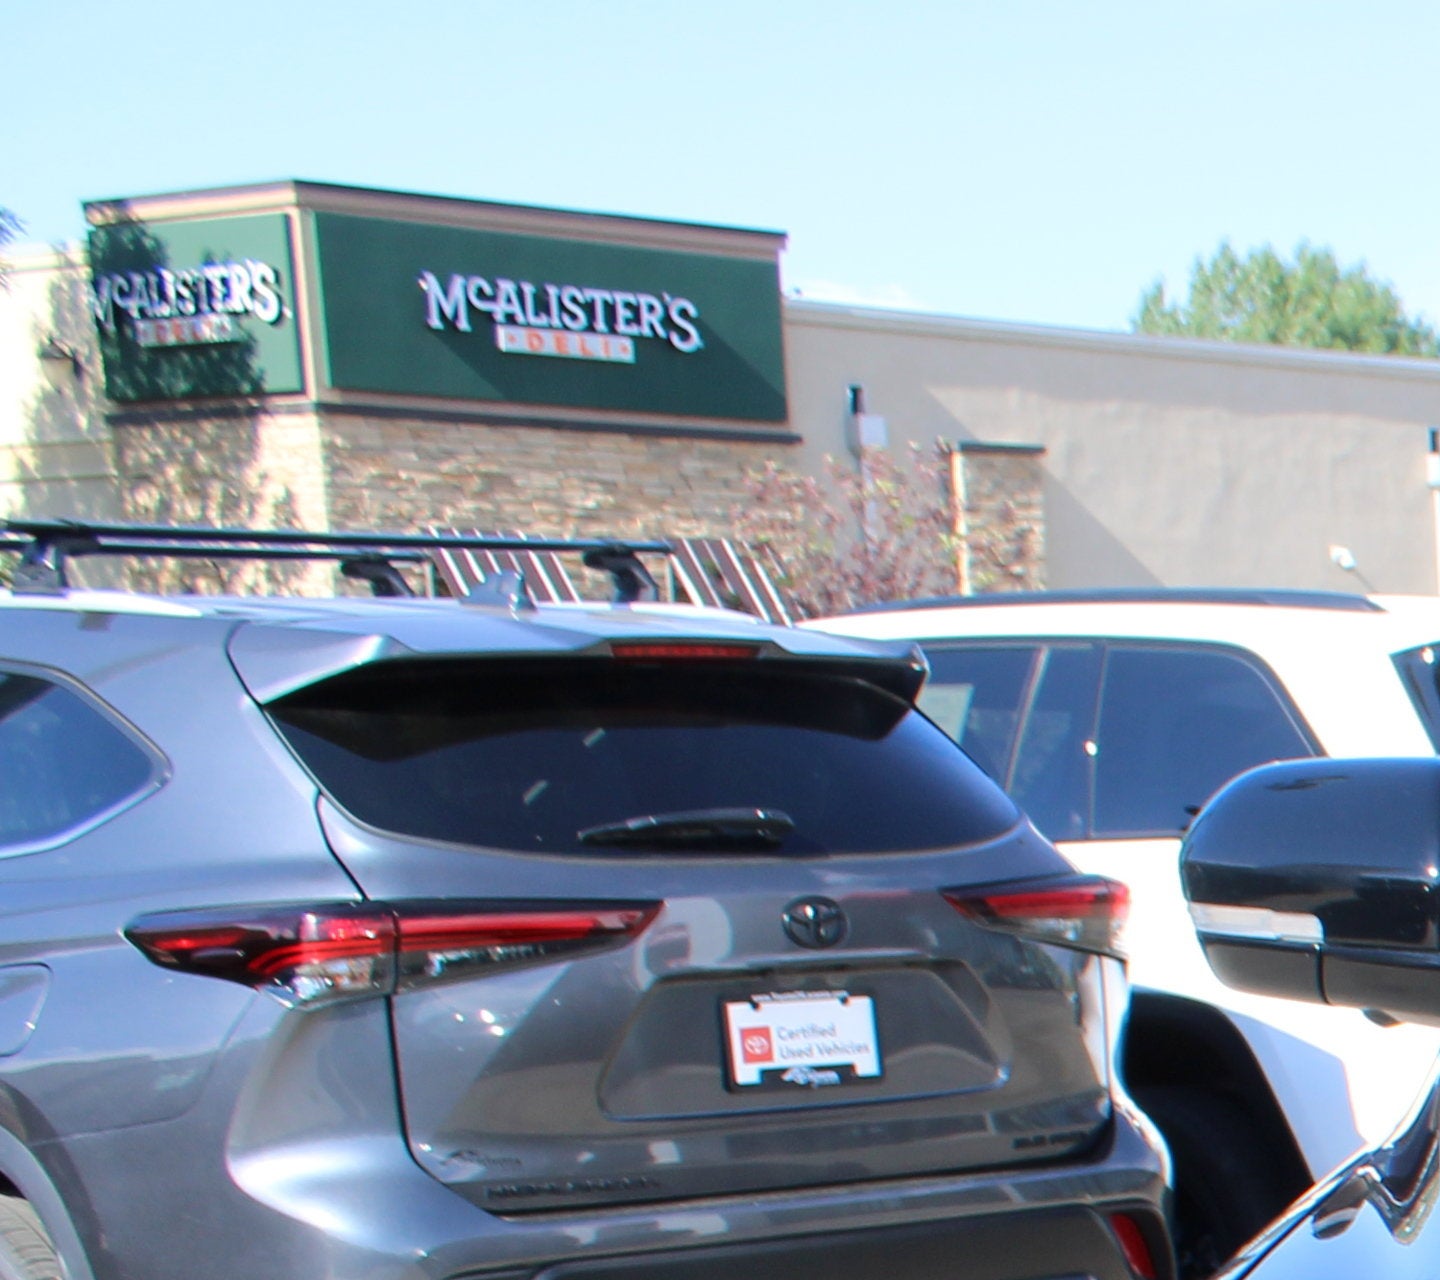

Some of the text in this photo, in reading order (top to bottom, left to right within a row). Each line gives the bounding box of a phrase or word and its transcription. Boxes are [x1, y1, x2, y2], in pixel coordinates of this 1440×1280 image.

[525, 327, 612, 359] DELI
[777, 1023, 837, 1041] Certified
[779, 1043, 814, 1060] Used
